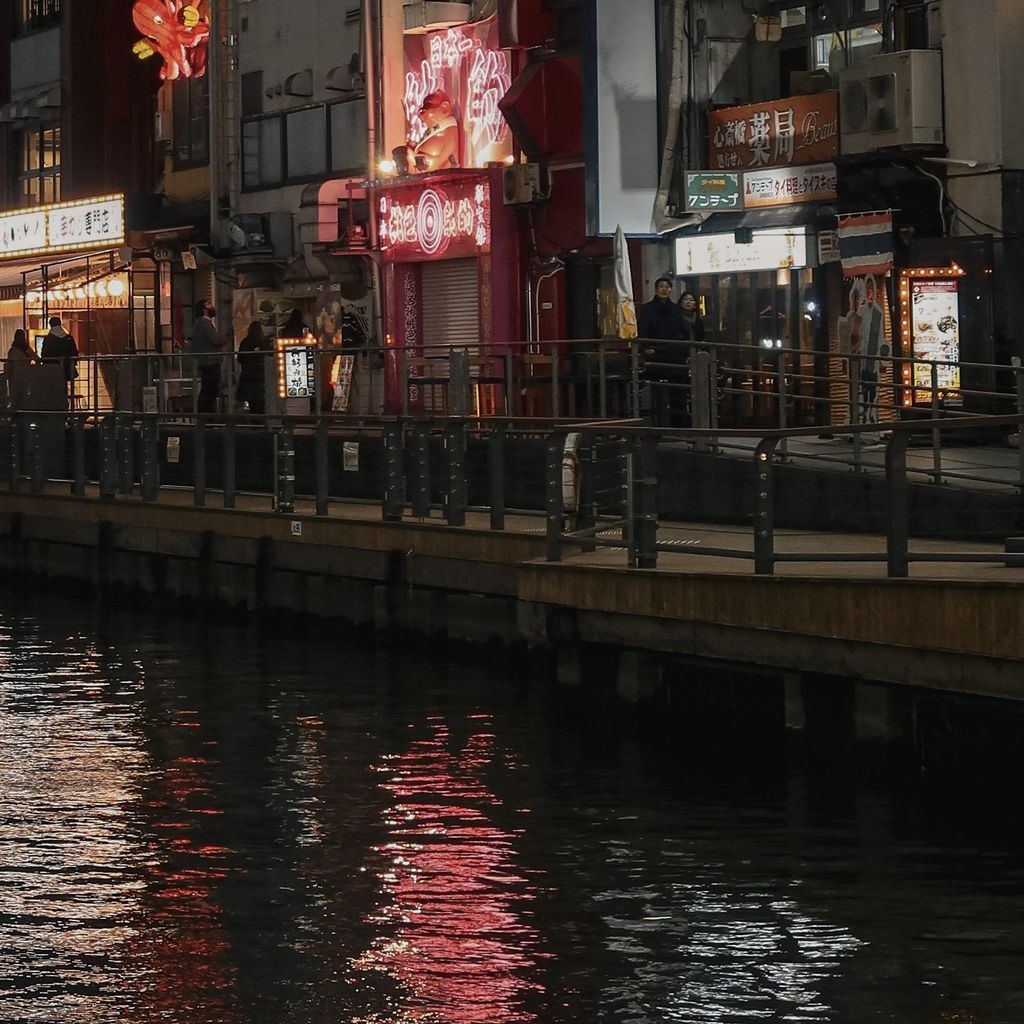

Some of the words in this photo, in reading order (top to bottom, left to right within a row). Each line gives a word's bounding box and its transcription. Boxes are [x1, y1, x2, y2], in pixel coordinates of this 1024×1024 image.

[430, 29, 473, 68] 日本一
[749, 107, 795, 166] 薬局
